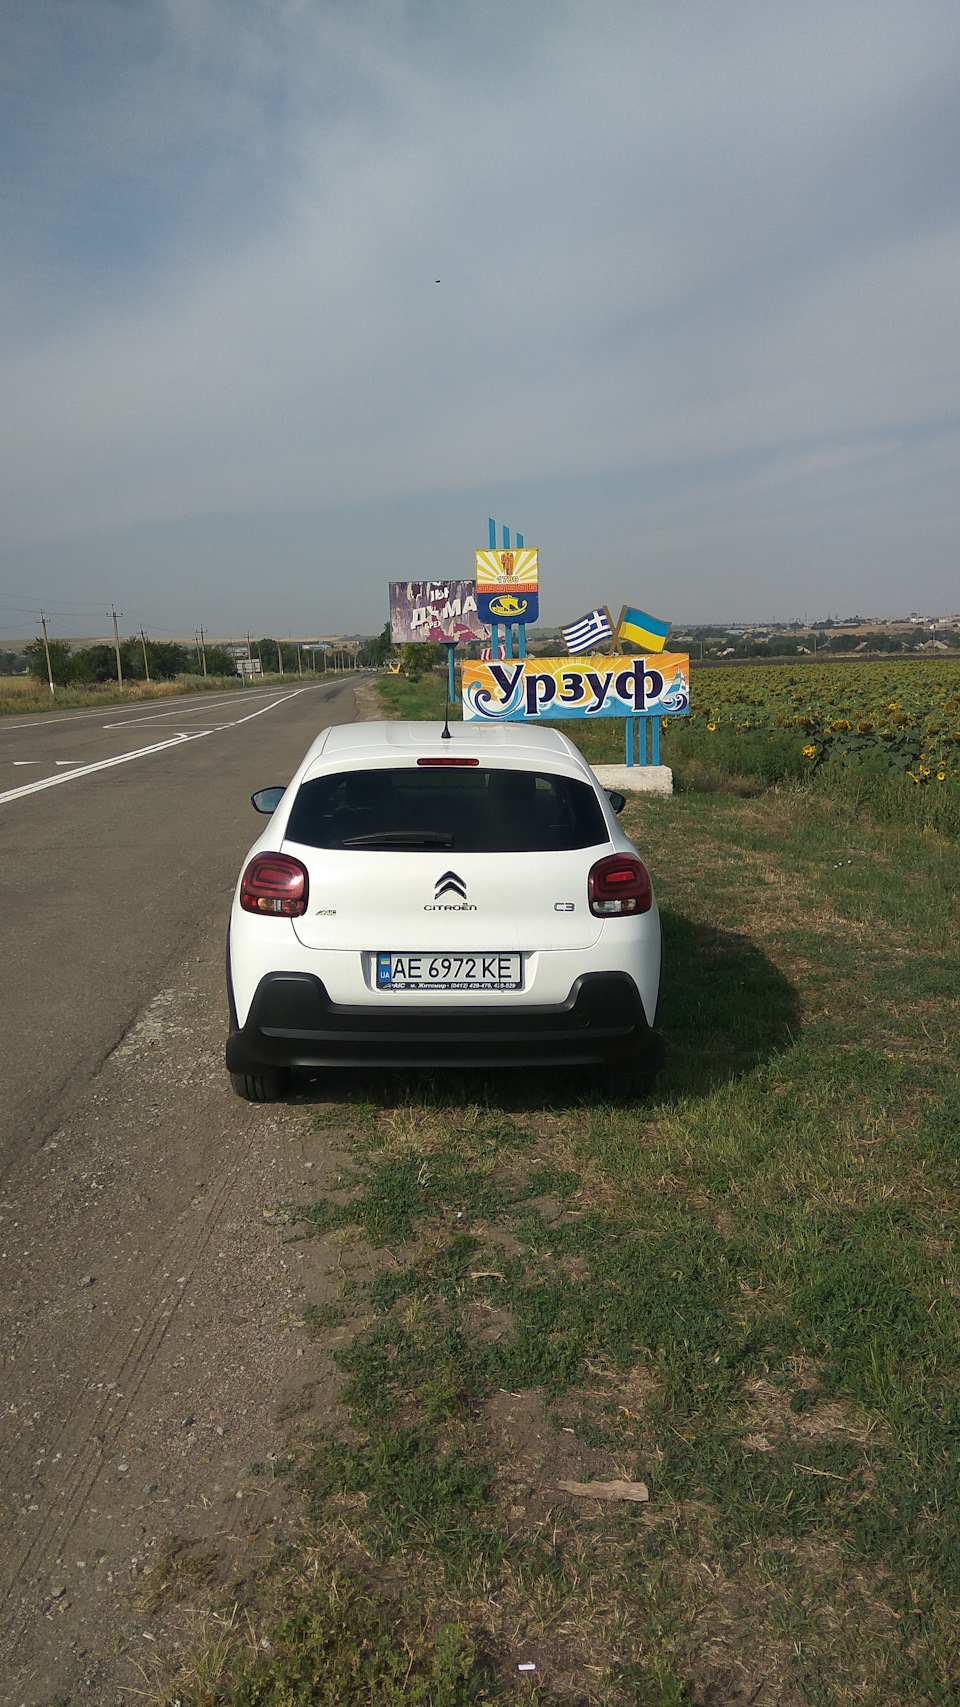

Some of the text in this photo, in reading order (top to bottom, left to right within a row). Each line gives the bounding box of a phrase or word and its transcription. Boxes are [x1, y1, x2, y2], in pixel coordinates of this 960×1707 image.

[496, 575, 519, 583] 1780
[487, 658, 665, 717] Урзуф
[423, 902, 478, 911] CITROËN
[553, 902, 576, 912] C3
[392, 958, 512, 979] AE 6972 KE
[380, 971, 390, 979] UA
